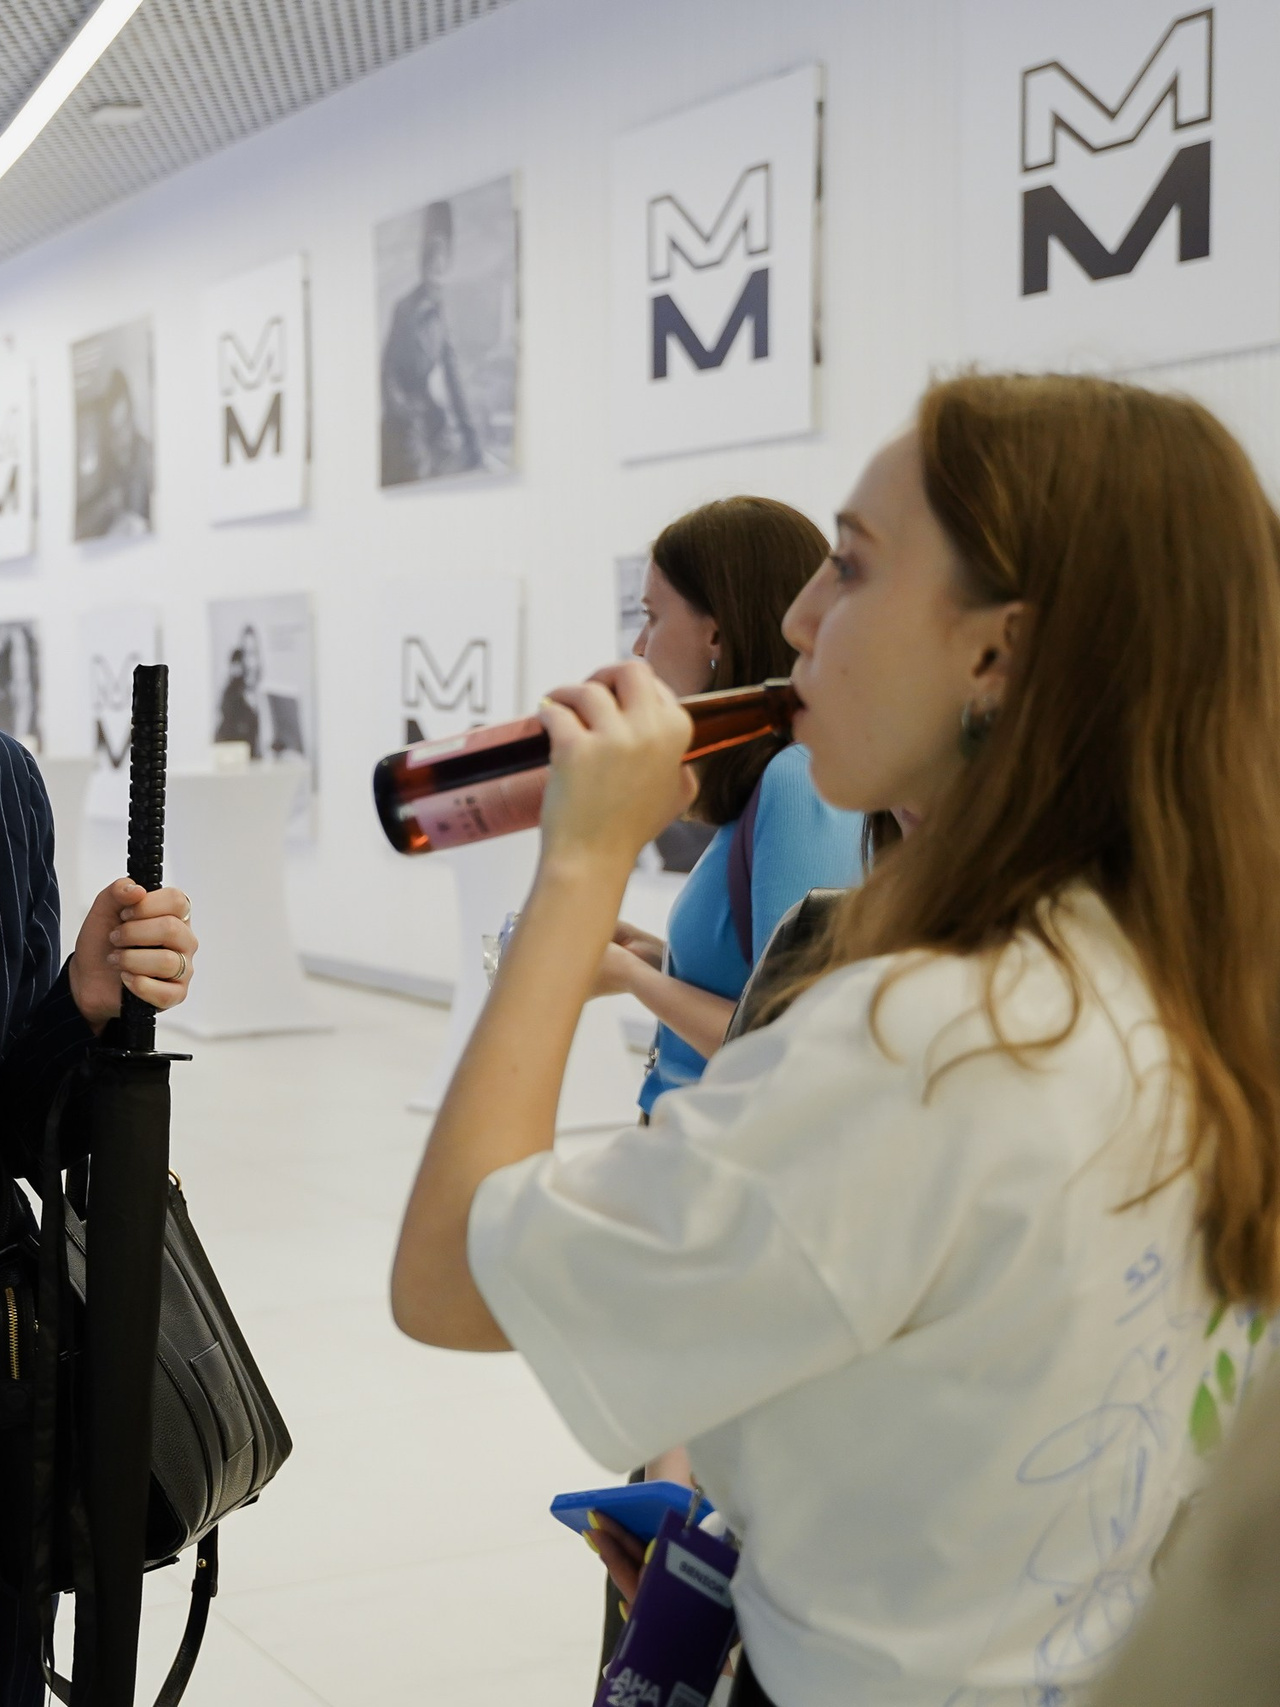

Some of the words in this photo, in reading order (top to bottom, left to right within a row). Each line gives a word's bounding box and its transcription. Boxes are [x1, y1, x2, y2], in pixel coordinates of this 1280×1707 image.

[1022, 7, 1213, 172] M
[647, 163, 770, 281] M
[1022, 140, 1211, 296] M
[652, 266, 769, 381] M
[224, 391, 282, 467] M
[402, 637, 488, 715] M
